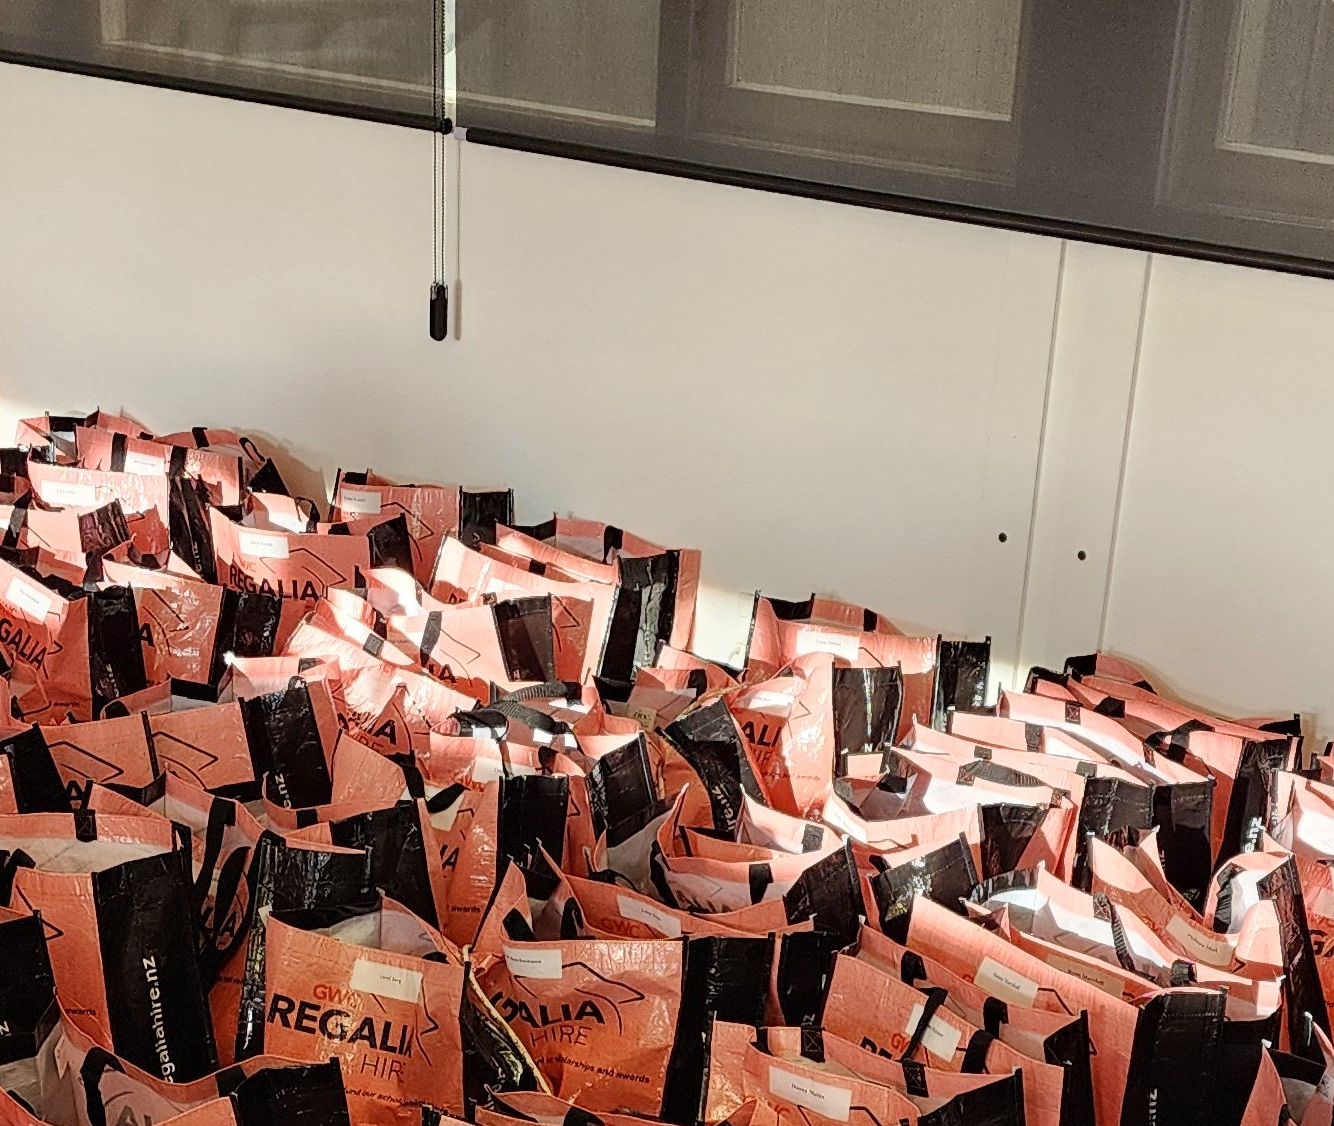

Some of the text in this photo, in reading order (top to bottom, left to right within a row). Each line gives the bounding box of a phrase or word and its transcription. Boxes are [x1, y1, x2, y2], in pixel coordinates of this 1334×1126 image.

[600, 919, 643, 939] GWC
[492, 990, 605, 1029] GALIA
[529, 1024, 592, 1048] HIRE
